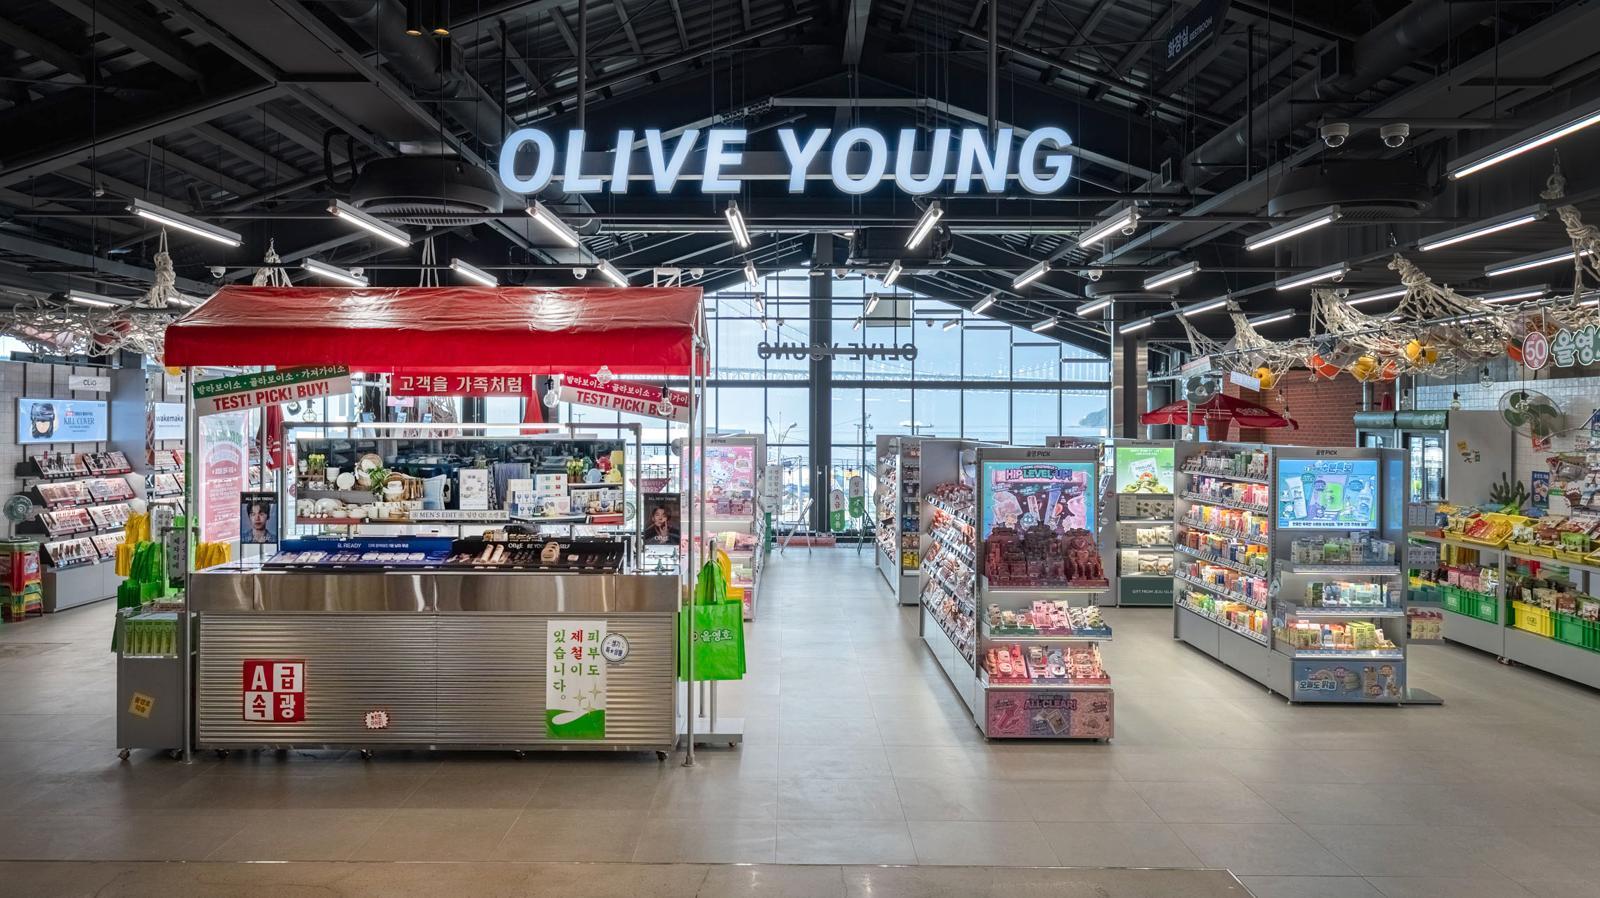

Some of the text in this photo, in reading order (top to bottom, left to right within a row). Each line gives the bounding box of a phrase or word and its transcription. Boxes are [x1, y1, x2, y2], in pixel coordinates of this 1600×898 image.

[499, 126, 1074, 194] OLIVE YOUNG
[1525, 339, 1546, 360] 50
[1553, 327, 1600, 364] 올영
[213, 381, 329, 411] TEST! PICK! BUY!
[400, 376, 522, 393] 고객을 가족처럼
[576, 390, 609, 405] TEST!
[612, 396, 645, 414] PICK!
[1006, 469, 1022, 480] HIP
[1023, 469, 1053, 480] LEVEL
[570, 629, 583, 677] 제철이
[587, 629, 600, 677] 피부도
[251, 664, 295, 690] A급
[252, 694, 296, 719] 속광
